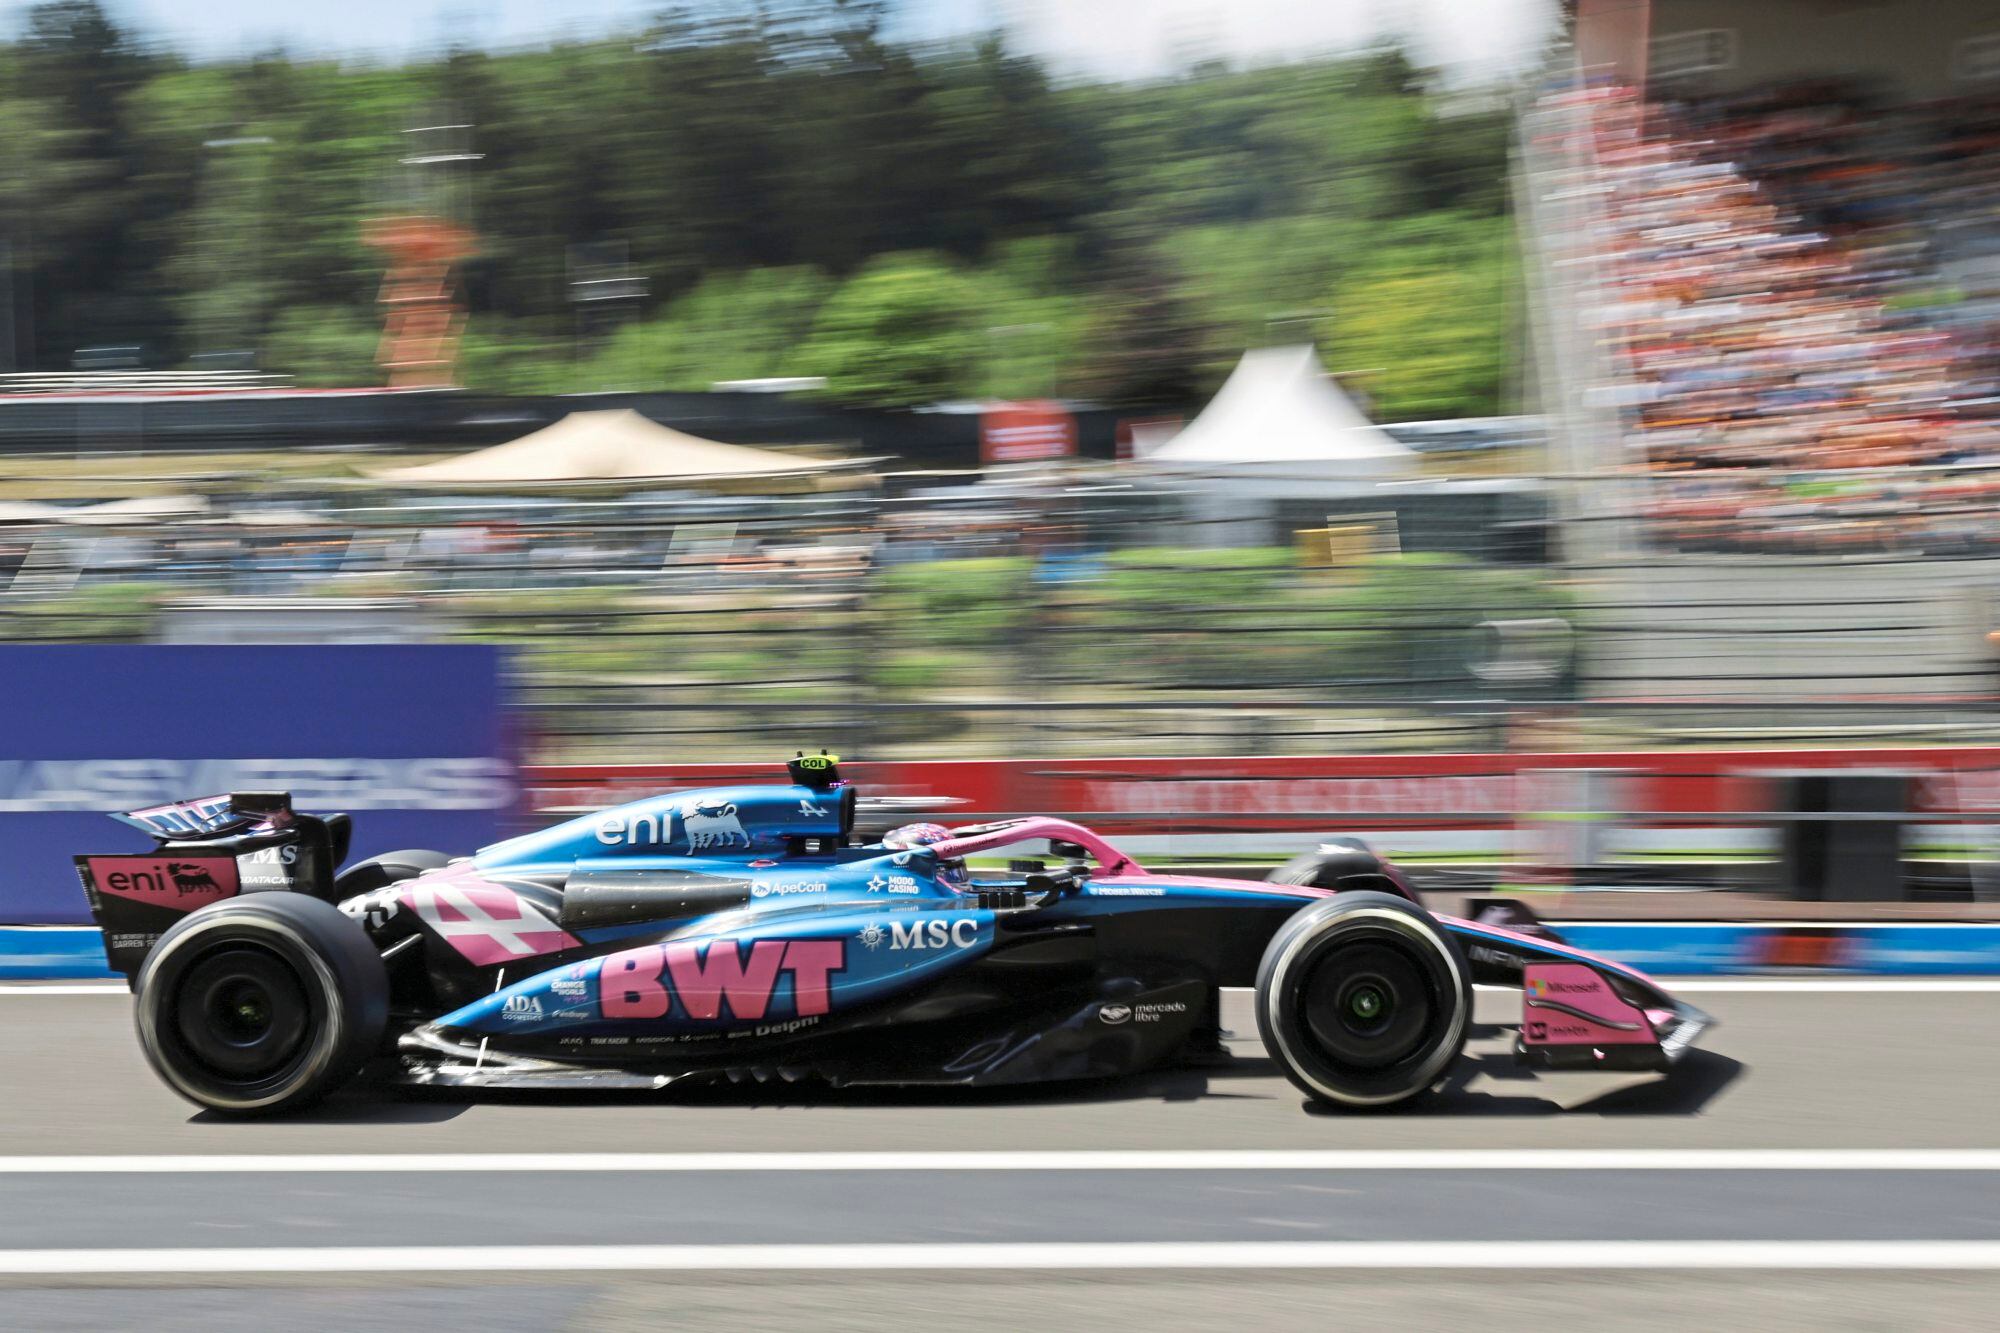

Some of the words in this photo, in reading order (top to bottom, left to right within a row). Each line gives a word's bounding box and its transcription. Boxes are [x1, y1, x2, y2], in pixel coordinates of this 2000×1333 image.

[802, 759, 825, 768] COL
[595, 802, 674, 846] eni
[107, 865, 165, 892] eni
[888, 876, 914, 885] MODO
[771, 881, 827, 895] ApeCoin
[888, 885, 920, 895] CASINO
[889, 919, 978, 951] MSC
[600, 940, 846, 1020] BWT
[502, 995, 543, 1012] ADA
[1135, 1001, 1186, 1012] mercado
[502, 1013, 543, 1021] COSMETICS
[1134, 1012, 1160, 1022] libre
